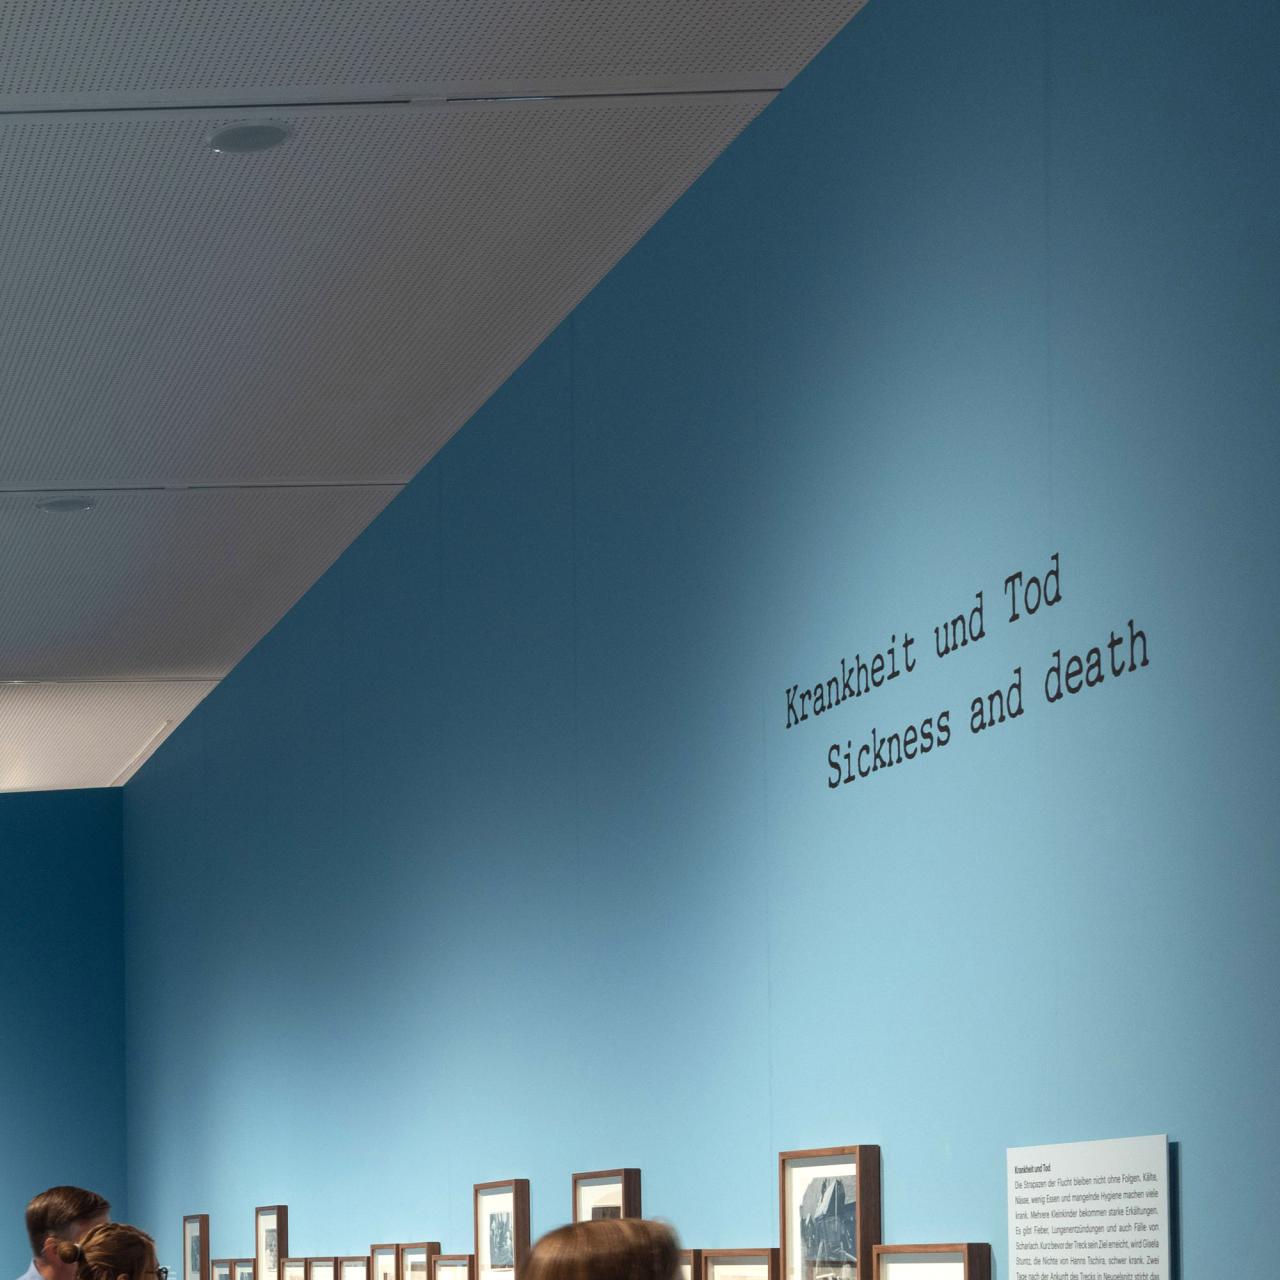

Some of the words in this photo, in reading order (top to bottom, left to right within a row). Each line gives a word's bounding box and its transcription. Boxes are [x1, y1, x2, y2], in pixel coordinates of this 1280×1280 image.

[785, 634, 916, 728] Krankheit
[934, 591, 986, 658] und
[1005, 552, 1062, 623] Tod
[828, 710, 951, 789] Sickness
[970, 667, 1024, 734] and
[1044, 619, 1150, 703] death
